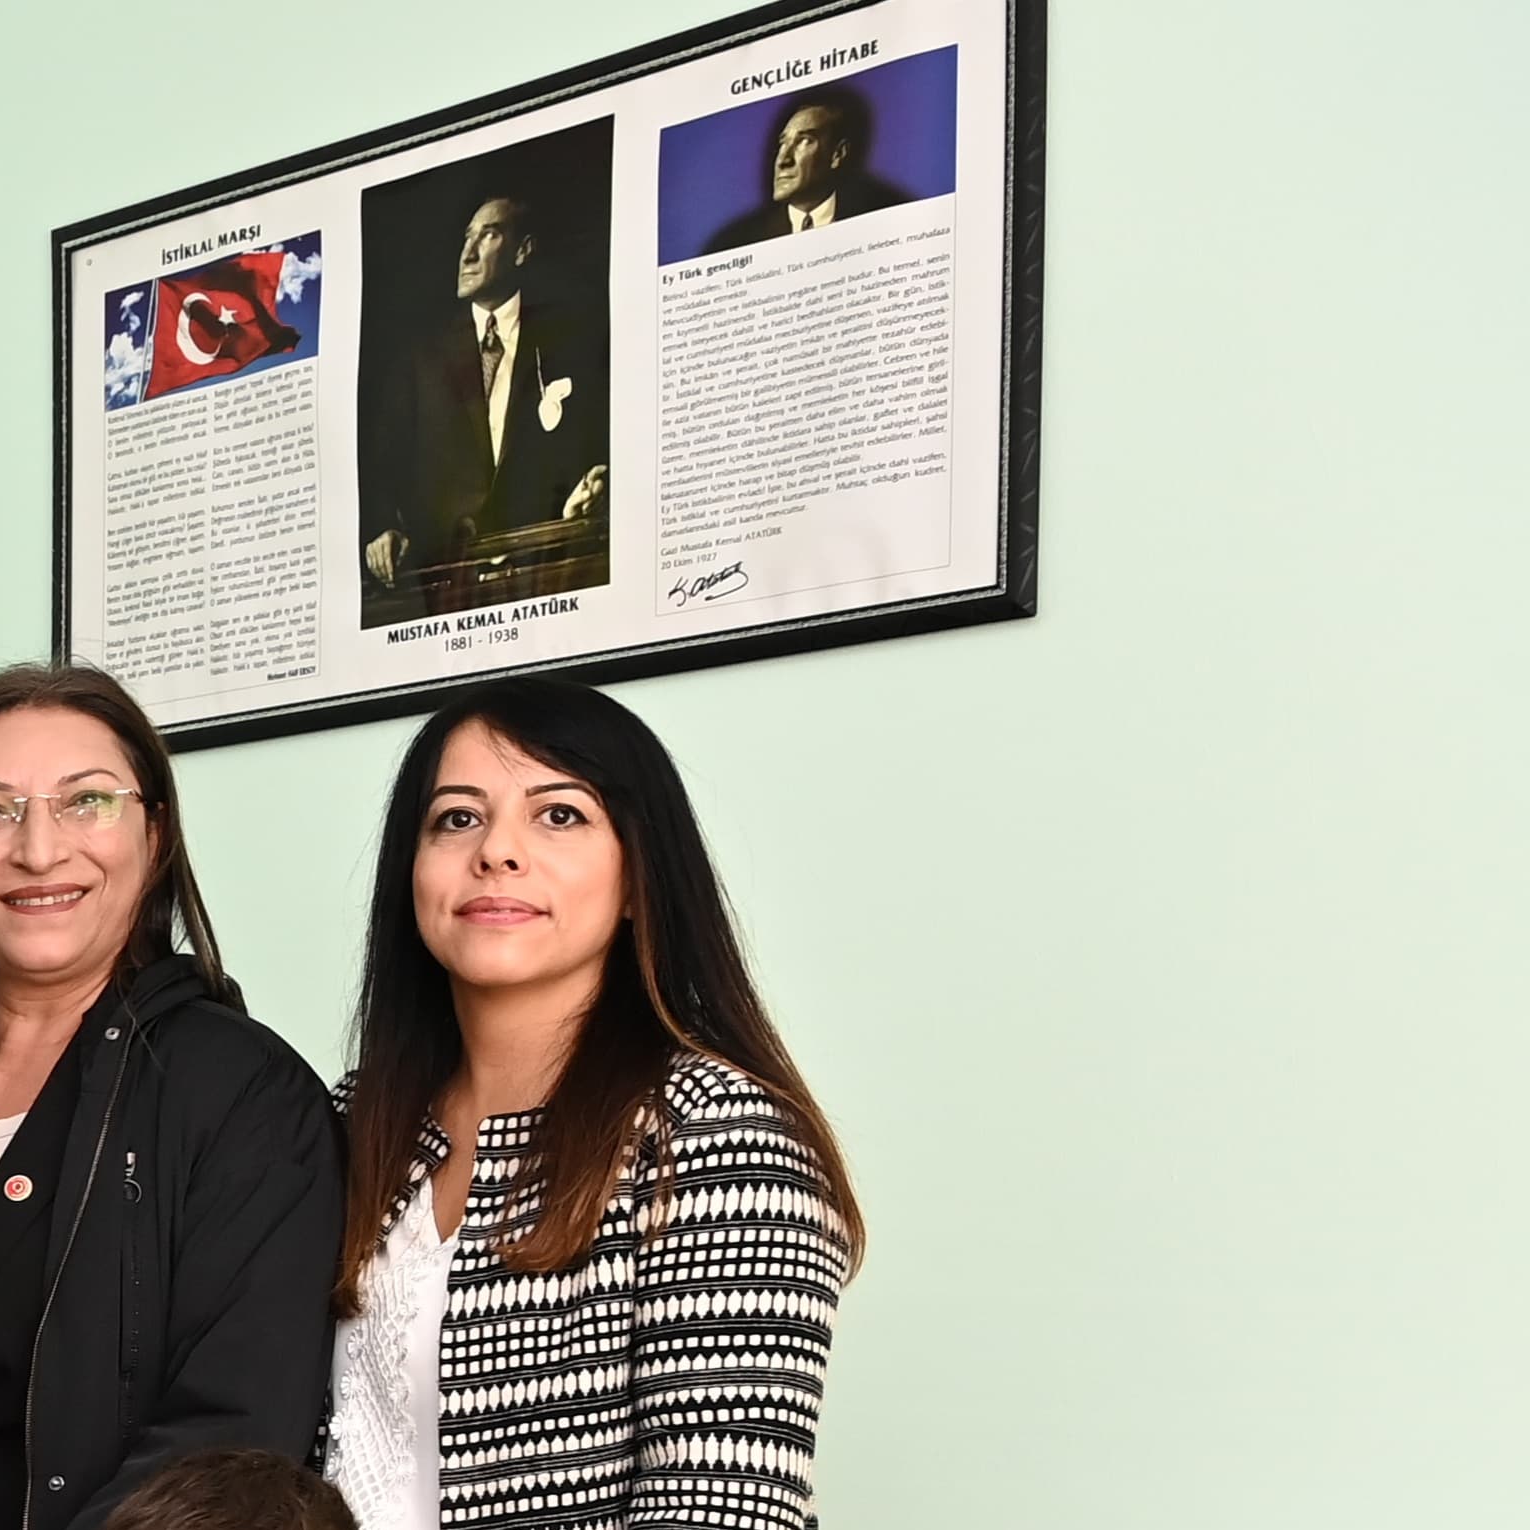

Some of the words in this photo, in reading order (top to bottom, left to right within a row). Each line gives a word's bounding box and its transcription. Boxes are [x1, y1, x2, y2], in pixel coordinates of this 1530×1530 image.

[731, 59, 812, 95] GENÇLİĞE
[819, 39, 879, 71] HİTABE
[161, 238, 214, 266] İSTİKLAL
[218, 223, 261, 249] MARŞI
[679, 267, 703, 281] Türk
[387, 620, 450, 644] MUSTAFA
[457, 610, 505, 631] KEMAL
[511, 597, 579, 621] ATATÜRK
[444, 635, 473, 652] 1881
[488, 627, 519, 645] 1938
